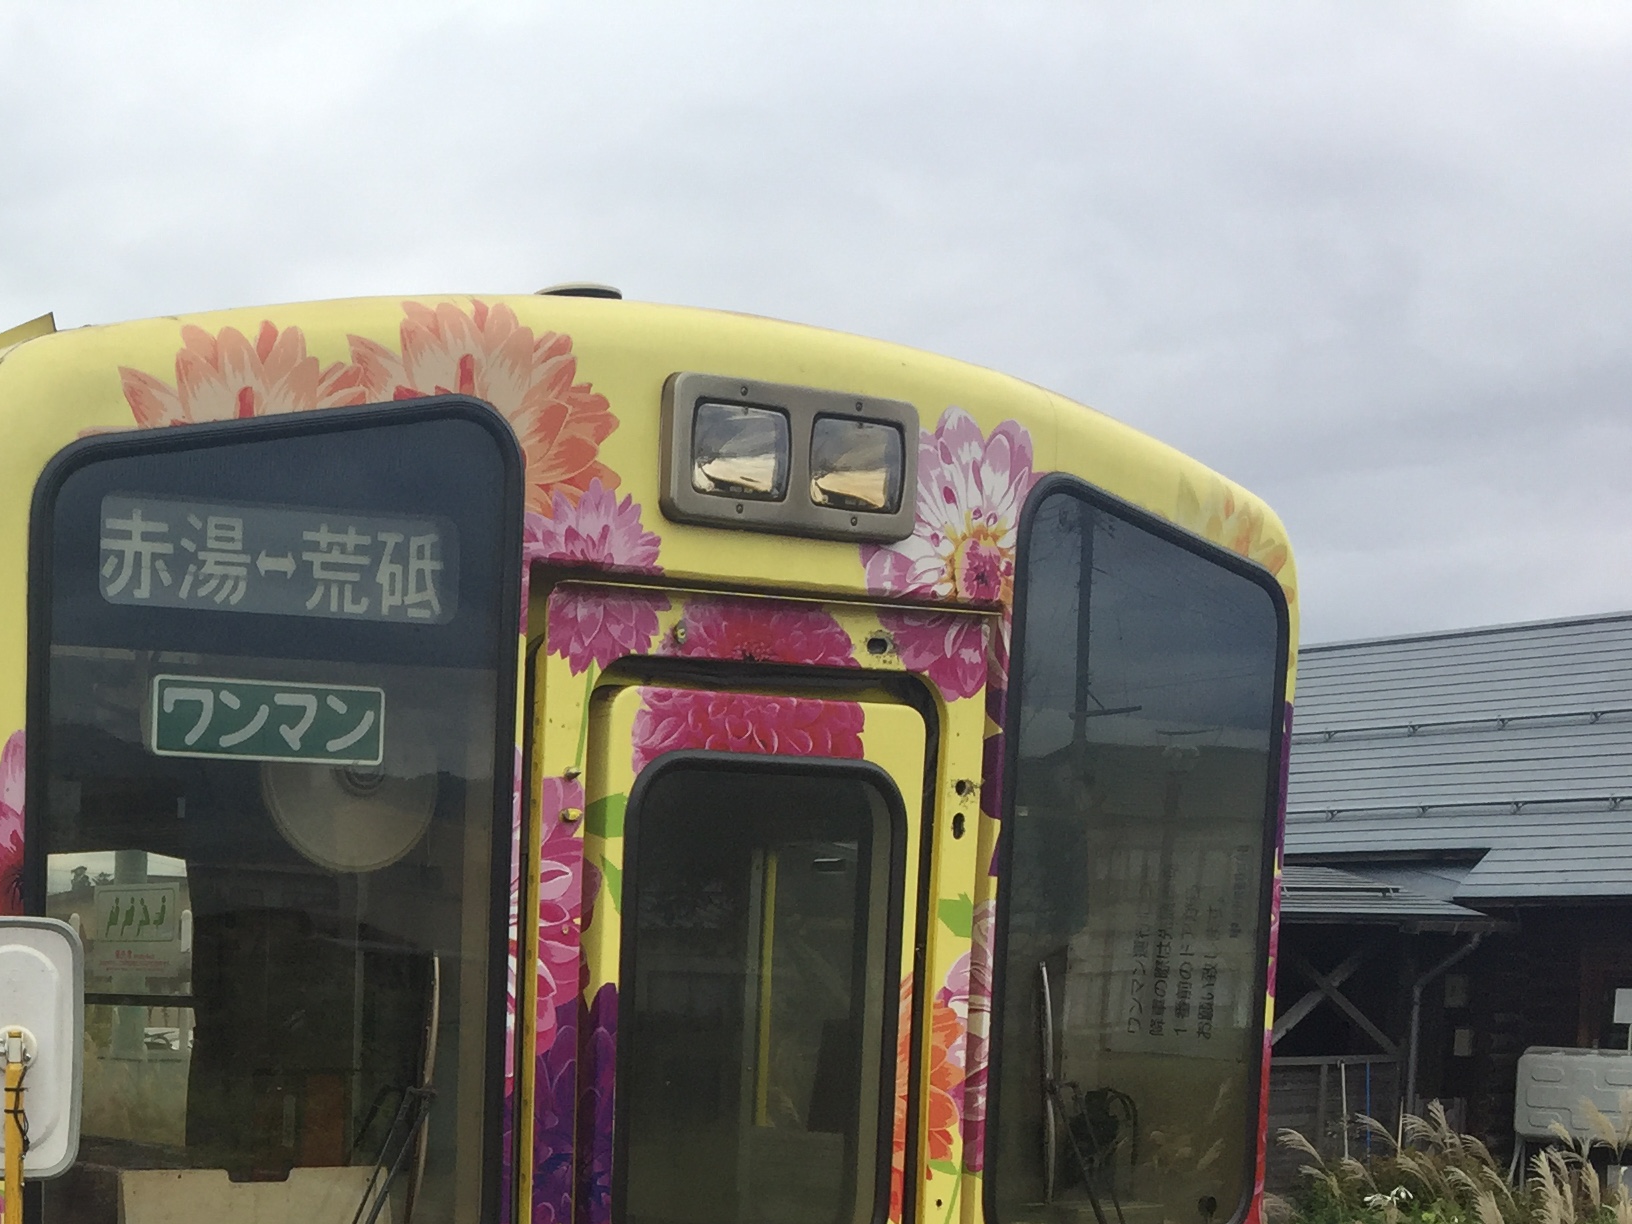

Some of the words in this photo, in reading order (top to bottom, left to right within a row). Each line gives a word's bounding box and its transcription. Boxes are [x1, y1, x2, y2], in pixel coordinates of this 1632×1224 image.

[100, 509, 252, 605] 赤湯
[302, 522, 444, 618] 荒砥
[162, 686, 376, 753] ワンマン
